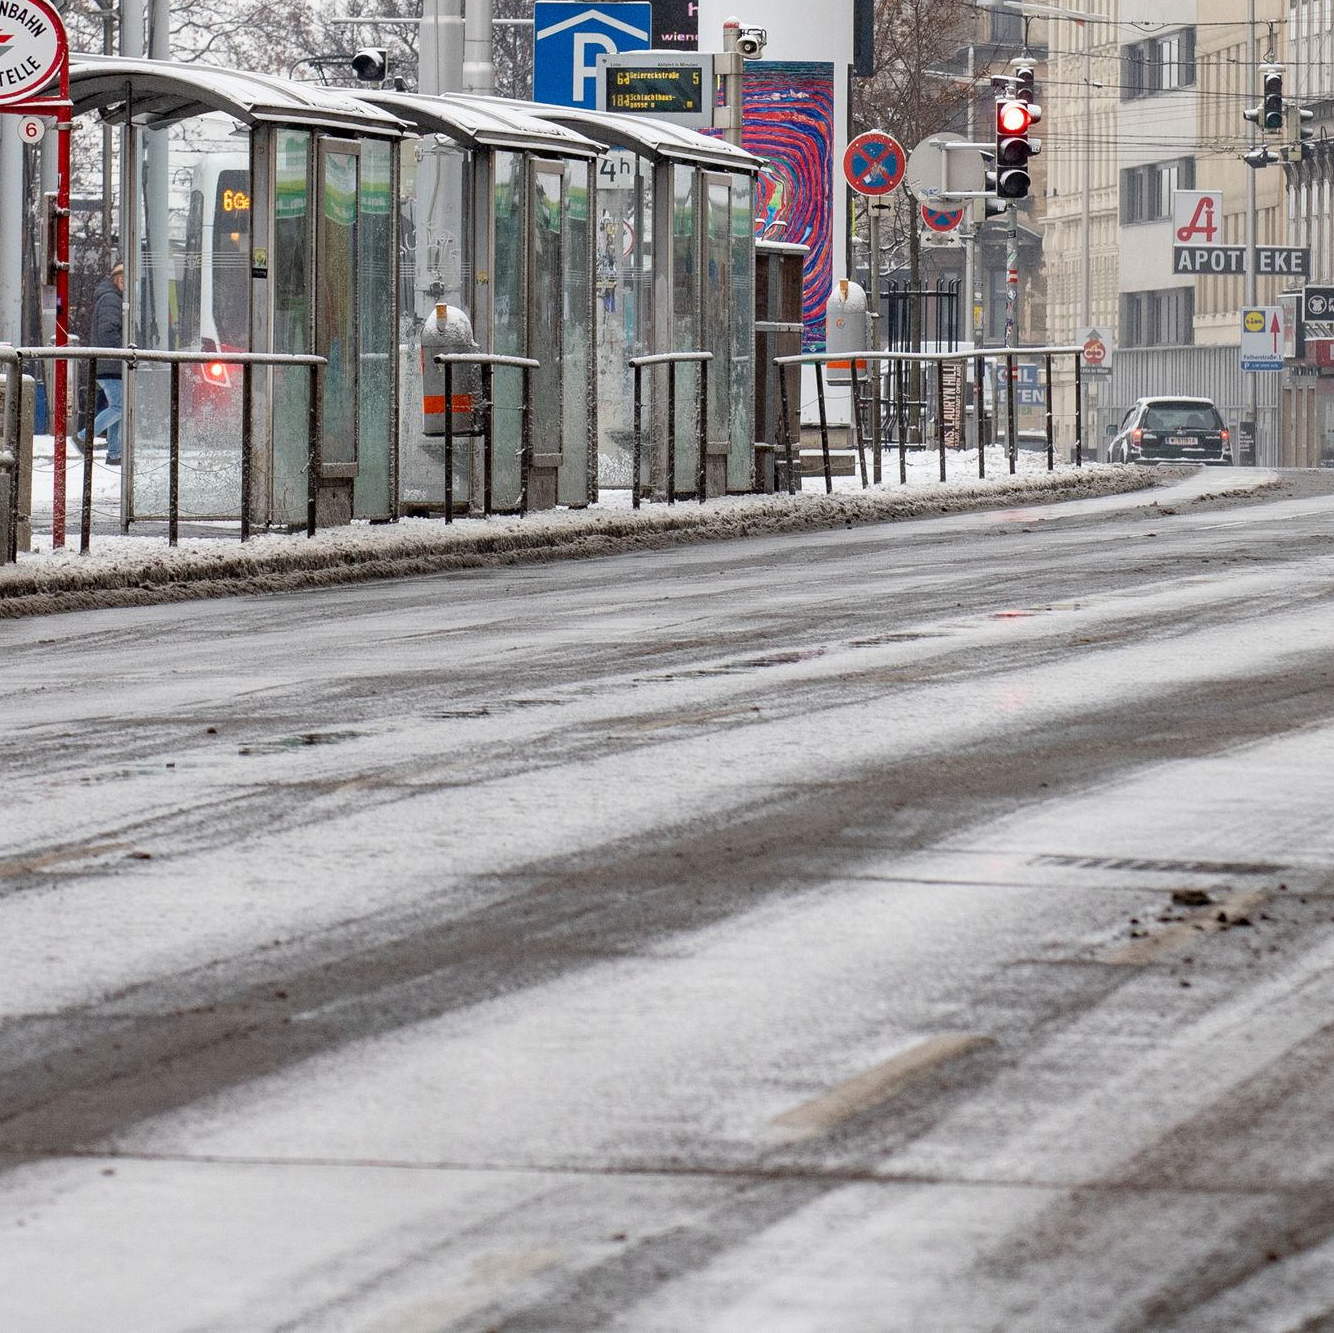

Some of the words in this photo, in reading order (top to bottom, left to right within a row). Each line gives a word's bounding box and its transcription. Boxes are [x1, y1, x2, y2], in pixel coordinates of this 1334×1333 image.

[693, 72, 700, 85] 5
[25, 122, 37, 138] 6
[223, 189, 233, 212] 6
[942, 387, 956, 427] LAURYN
